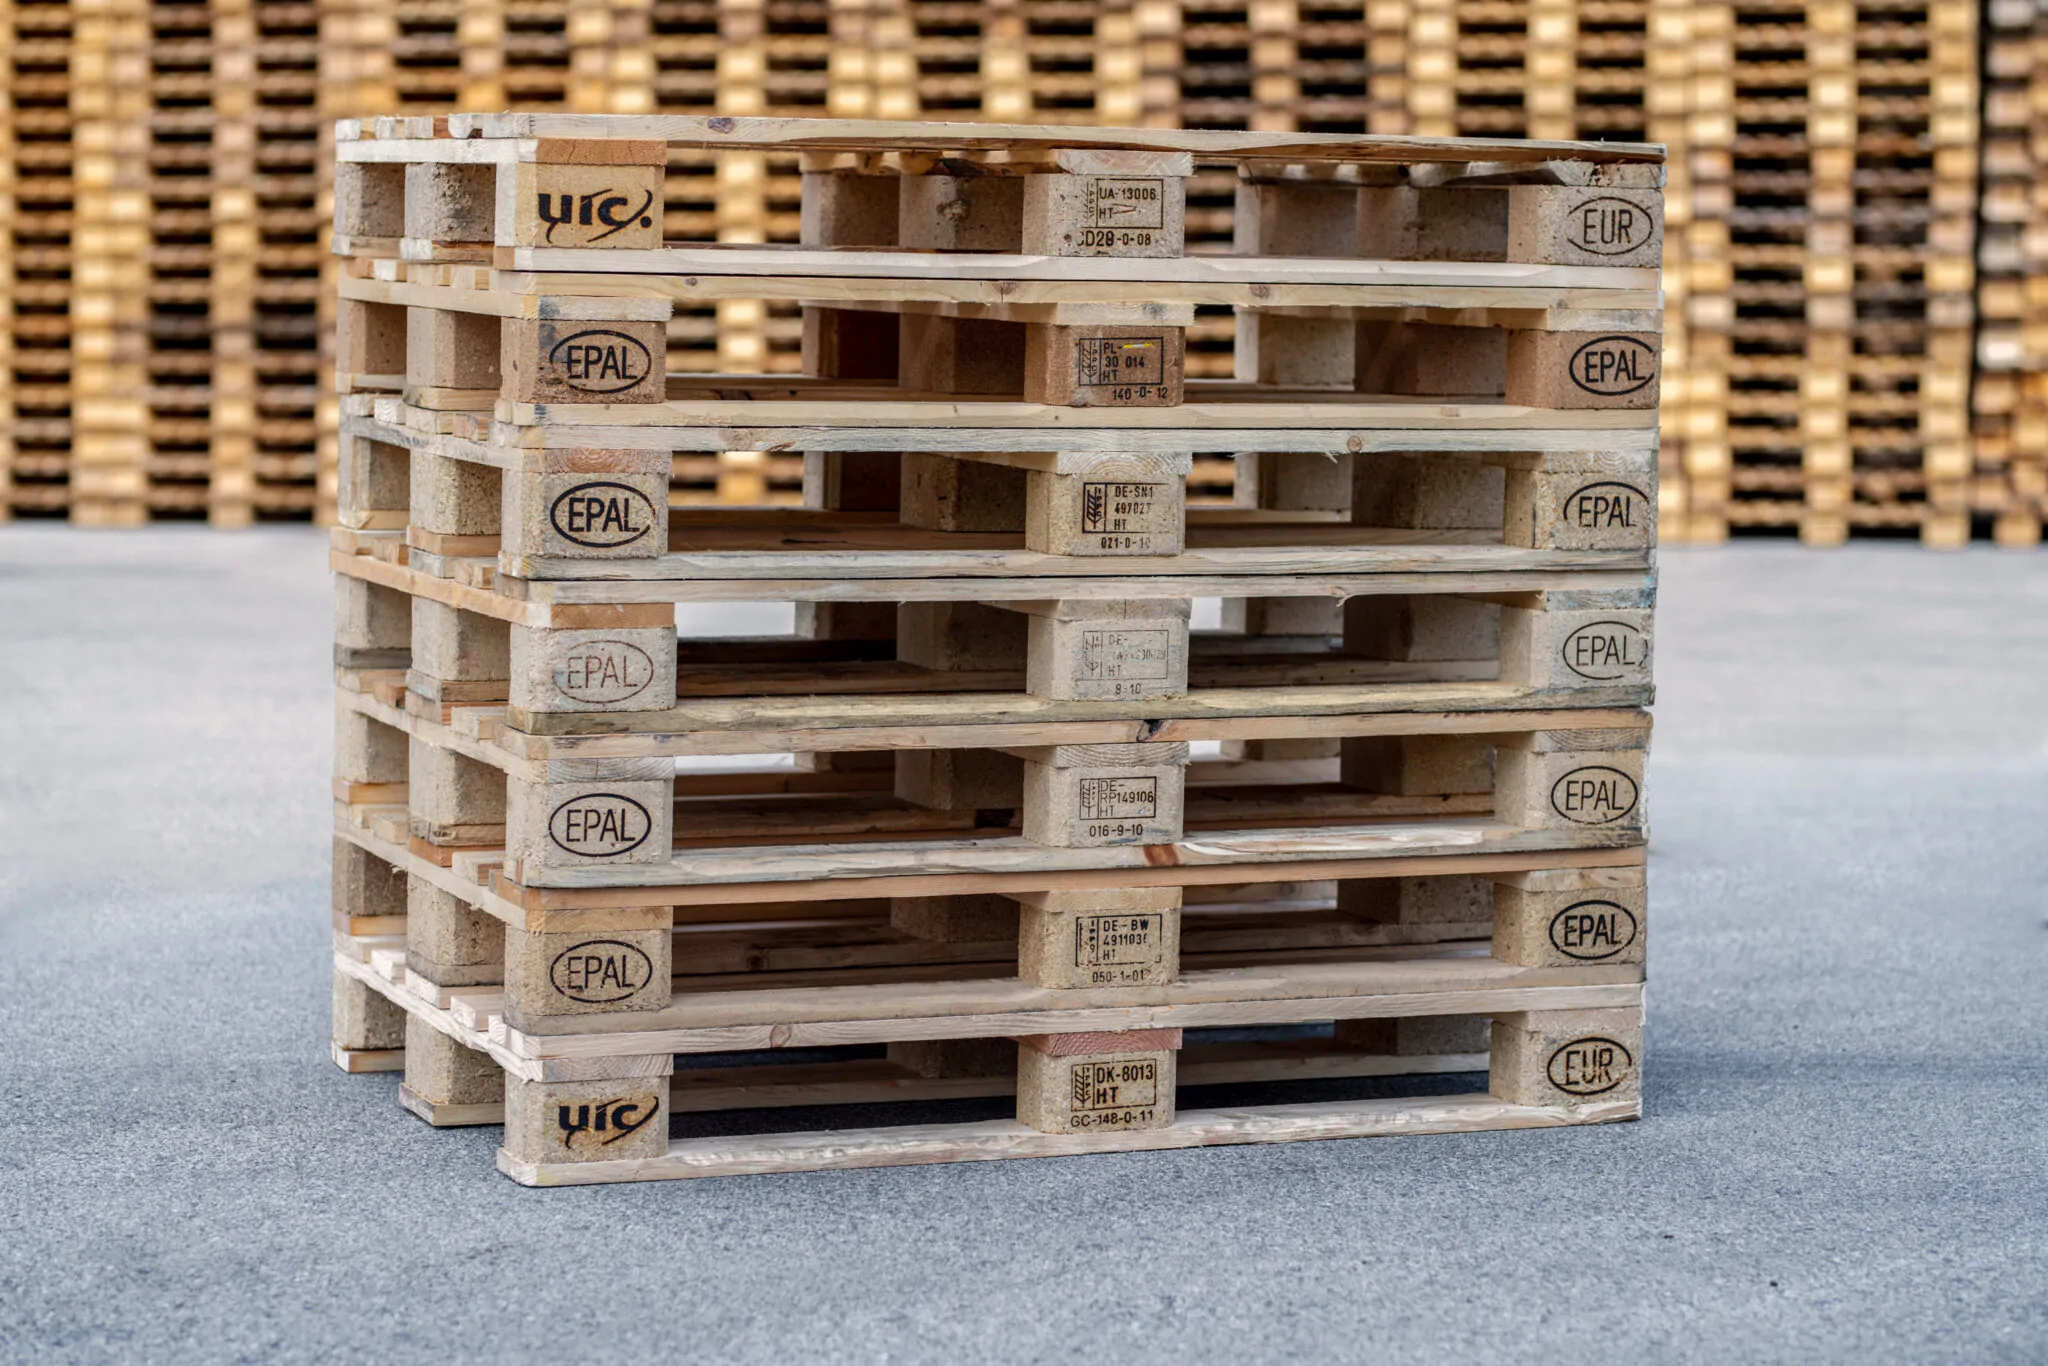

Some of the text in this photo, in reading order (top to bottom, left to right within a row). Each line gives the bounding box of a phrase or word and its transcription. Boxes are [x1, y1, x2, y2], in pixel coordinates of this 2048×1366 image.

[1099, 208, 1114, 218] HT
[1584, 209, 1632, 244] EUR
[567, 345, 638, 380] EPAL
[1103, 371, 1118, 381] HT
[1585, 350, 1646, 383] EPAL
[568, 497, 640, 532] EPAL
[1114, 519, 1126, 530] HT
[1578, 496, 1637, 528] EPAL
[1576, 635, 1635, 666] EPAL
[567, 655, 638, 689] EPAL
[1566, 780, 1624, 810] EPAL
[566, 808, 635, 842] EPAL
[1100, 806, 1114, 816] HT
[1090, 824, 1143, 837] 016-9-10
[1564, 914, 1621, 946] EPAL
[1103, 950, 1115, 961] HT
[567, 955, 634, 990] EPAL
[1096, 1064, 1153, 1084] DK-8013
[1566, 1048, 1613, 1085] EUR
[1096, 1086, 1118, 1104] HT
